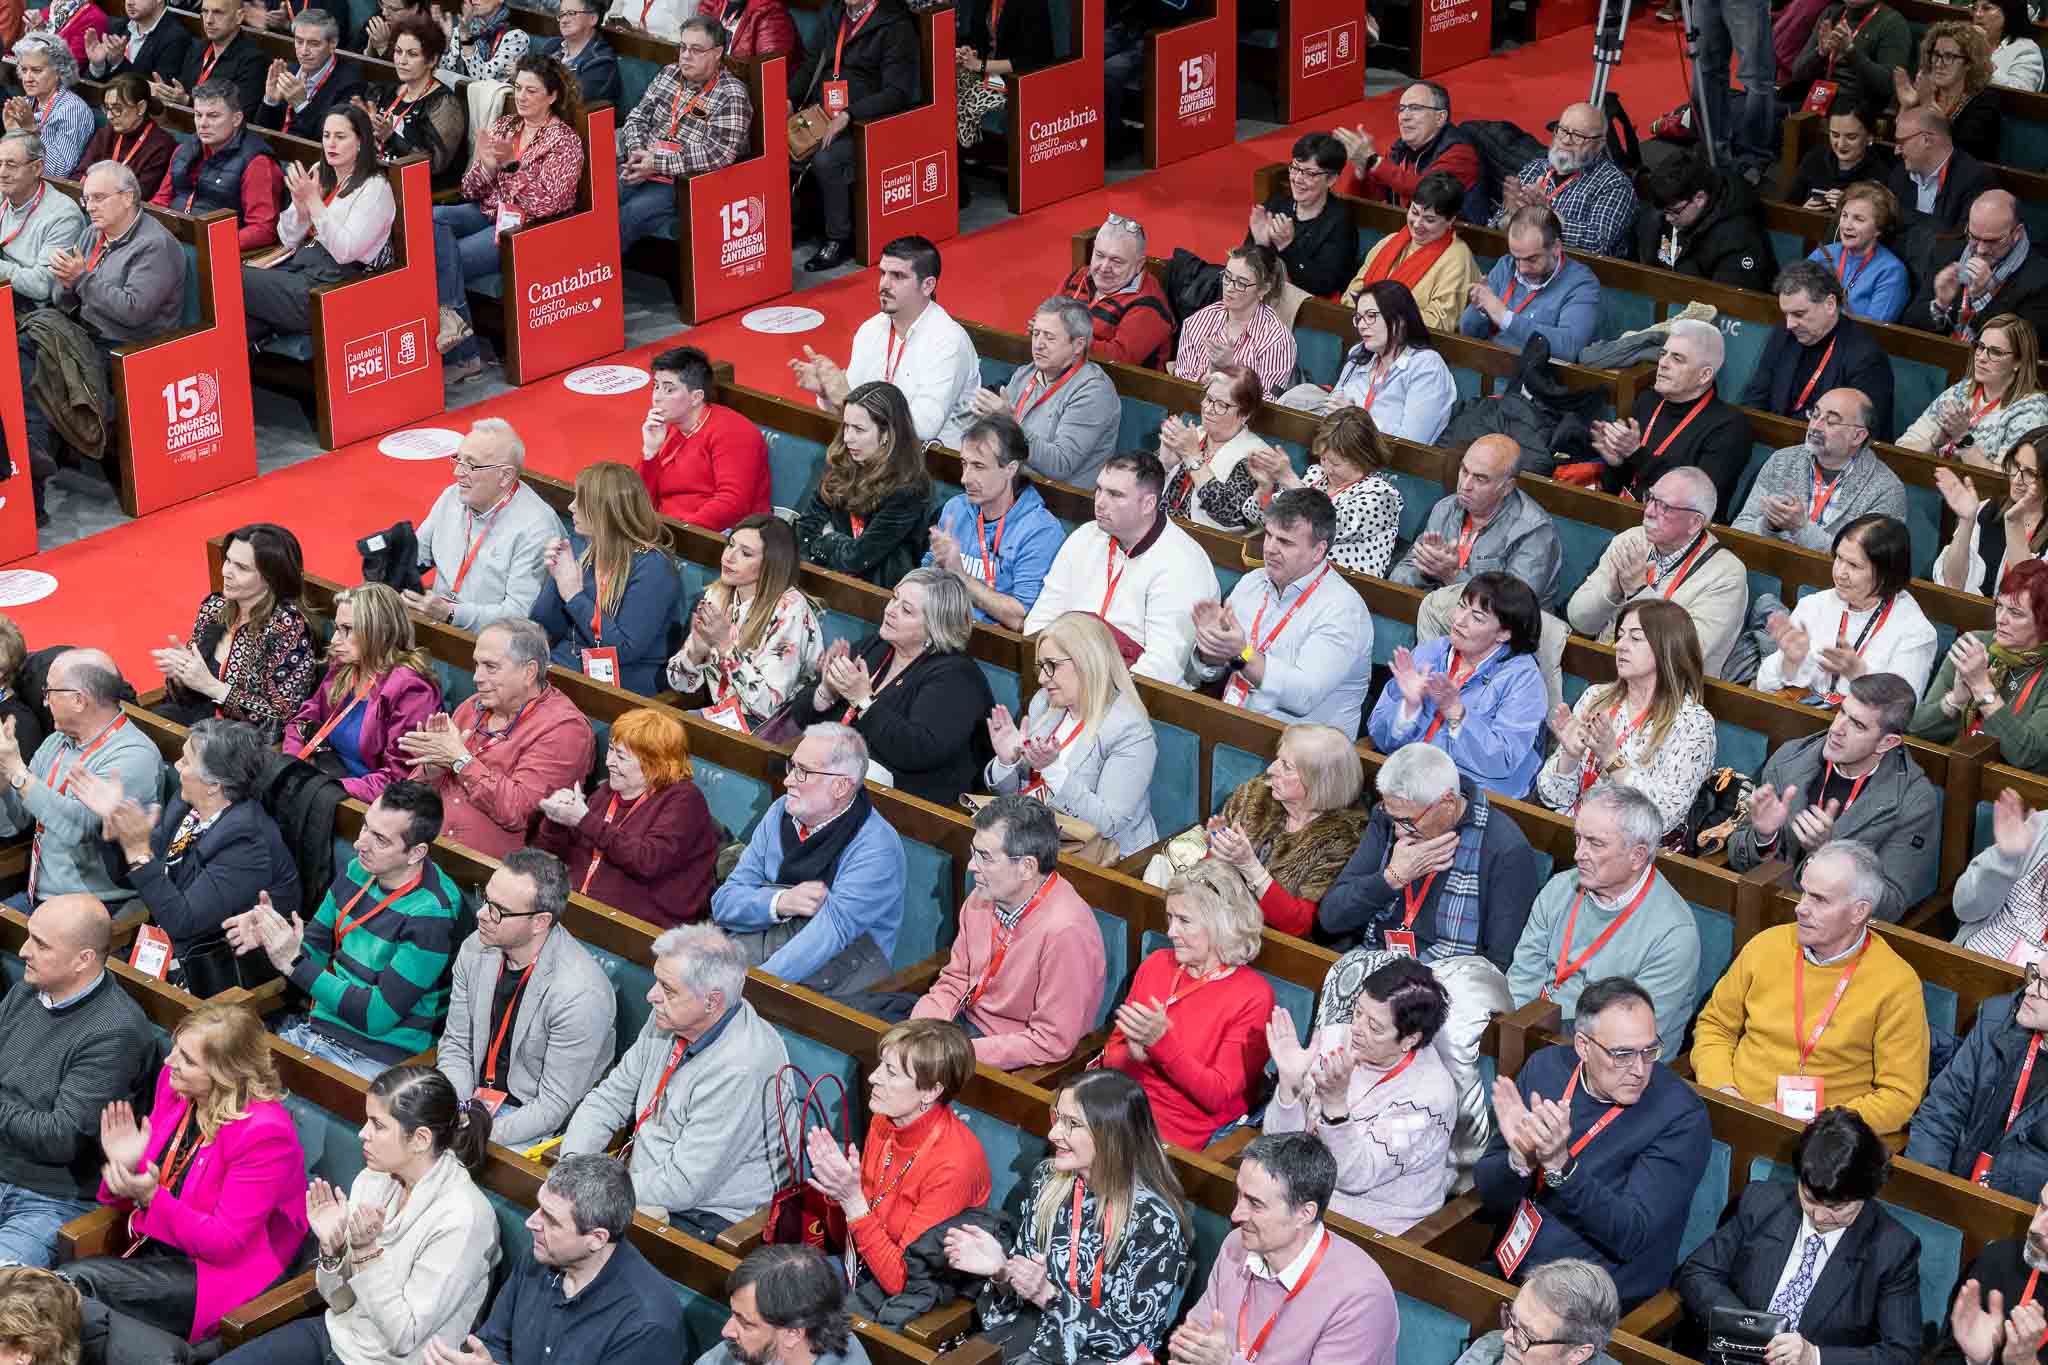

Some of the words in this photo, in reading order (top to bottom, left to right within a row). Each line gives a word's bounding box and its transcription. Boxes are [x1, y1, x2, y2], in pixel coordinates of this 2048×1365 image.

[1305, 50, 1327, 69] PSOE
[1179, 56, 1203, 94] 15
[1179, 96, 1214, 115] CANTABRIA
[1180, 86, 1214, 105] CONGRESO
[1030, 106, 1098, 141] Cantabria
[1030, 136, 1060, 155] nuestro
[884, 184, 912, 205] PSOE
[720, 199, 750, 241] 15
[721, 243, 765, 265] CANTABRIA
[722, 232, 763, 254] CONGRESO
[528, 262, 613, 304] Cantabria
[529, 298, 566, 319] nuestro
[347, 346, 382, 364] Cantabria
[349, 356, 384, 382] PSOE
[162, 376, 200, 424] 15
[168, 412, 218, 438] CONGRESO
[167, 424, 221, 450] CANTABRIA
